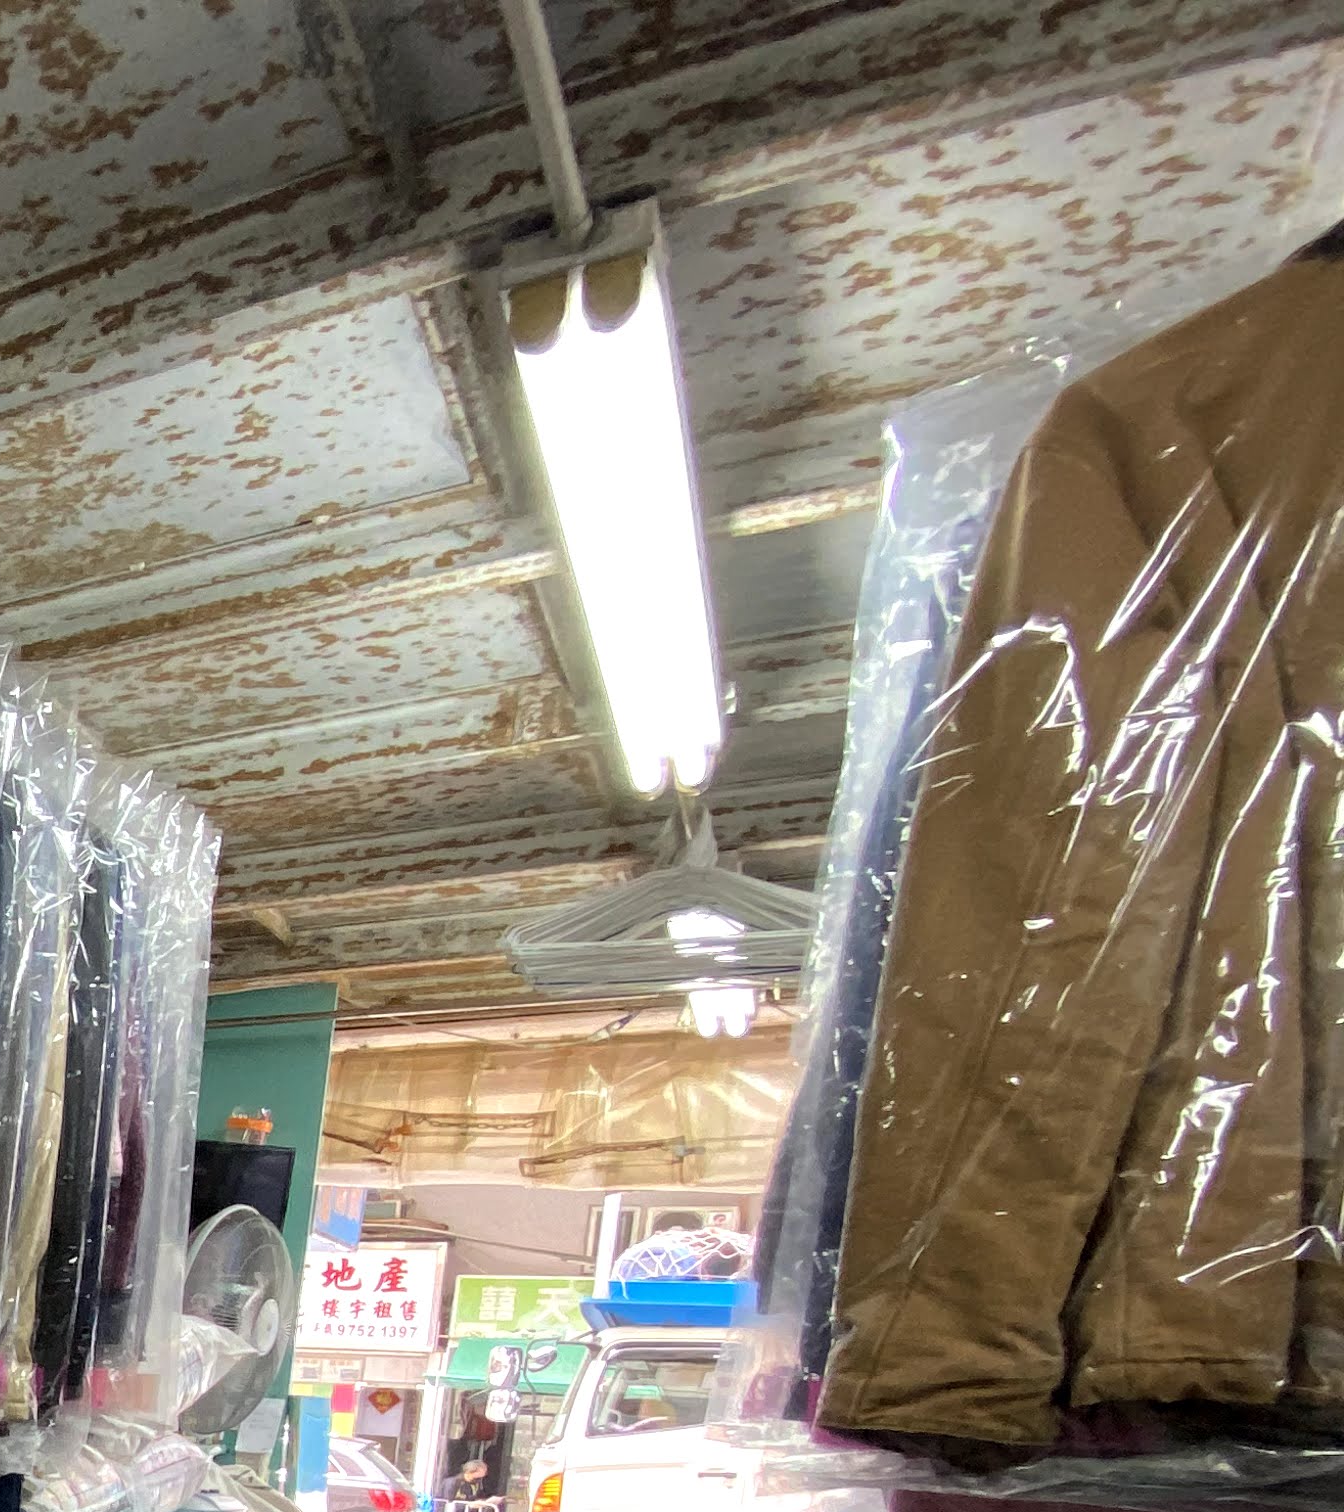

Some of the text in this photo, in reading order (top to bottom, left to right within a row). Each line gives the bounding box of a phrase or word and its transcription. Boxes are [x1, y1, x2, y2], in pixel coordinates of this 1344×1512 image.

[322, 1257, 409, 1293] 地產
[337, 1324, 376, 1338] 9752
[381, 1326, 418, 1339] 1397
